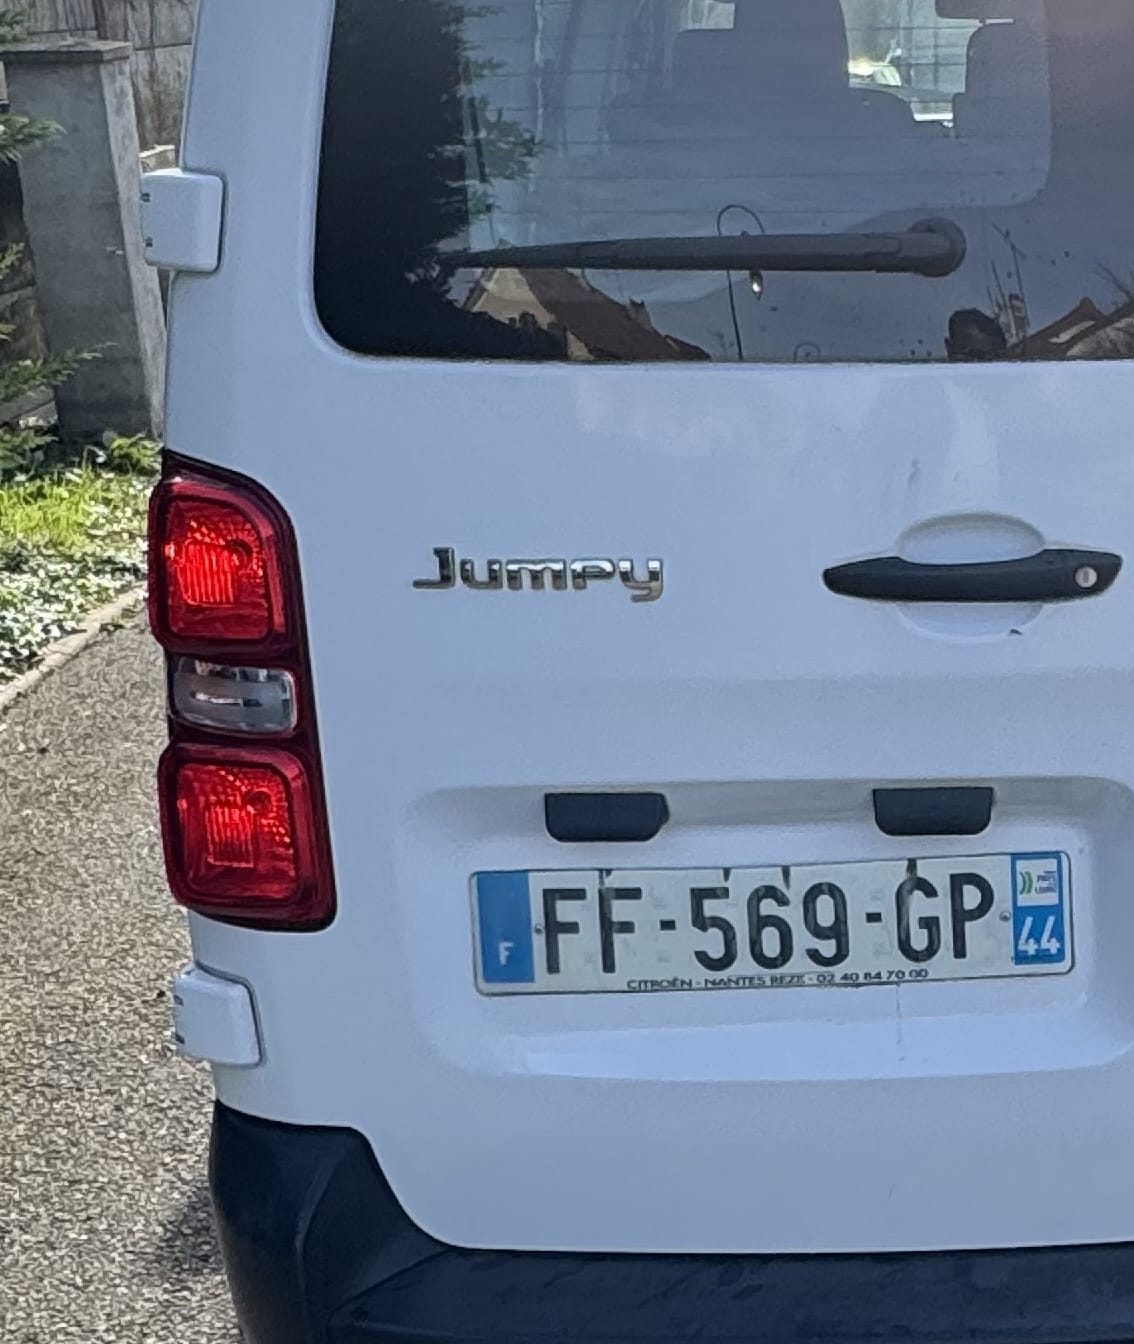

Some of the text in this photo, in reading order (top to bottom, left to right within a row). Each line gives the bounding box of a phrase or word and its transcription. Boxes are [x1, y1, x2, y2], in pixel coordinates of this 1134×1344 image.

[412, 546, 664, 602] Jumpy
[542, 872, 995, 974] FF-569-GP
[1017, 915, 1061, 956] 44
[499, 941, 515, 966] F
[704, 976, 766, 988] NANTES
[816, 972, 835, 984] 02
[840, 971, 859, 982] 40
[886, 969, 905, 981] 70
